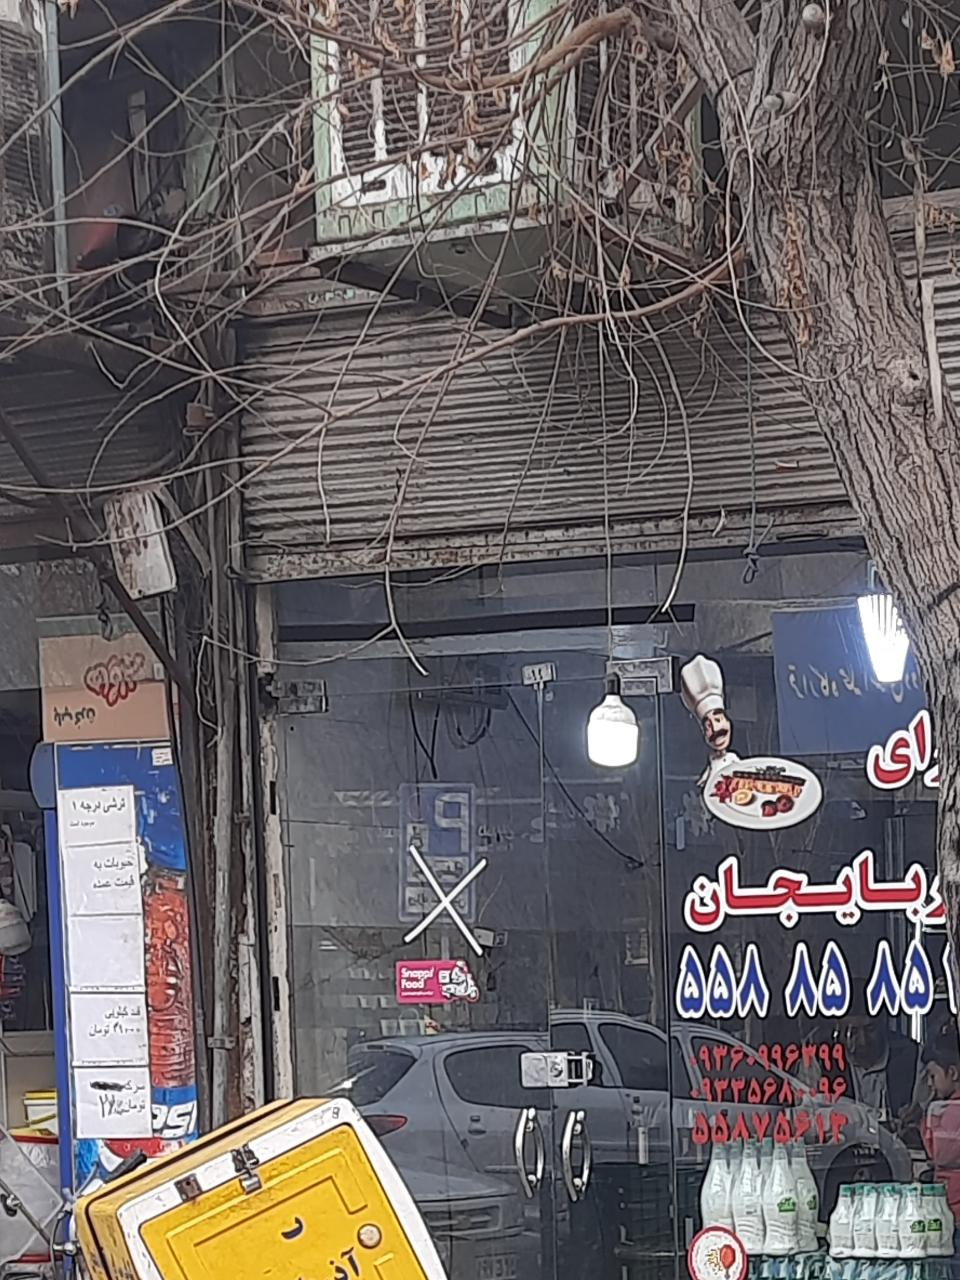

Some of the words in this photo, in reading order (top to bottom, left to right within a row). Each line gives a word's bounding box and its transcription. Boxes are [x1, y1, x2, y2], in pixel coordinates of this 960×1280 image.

[870, 712, 940, 786] ای
[678, 945, 769, 1017] ۵۵۸
[786, 941, 849, 1016] ۸۵
[867, 939, 934, 1014] ۸۵
[691, 1110, 848, 1144] ۵۵۸۷۵۶۱۳
